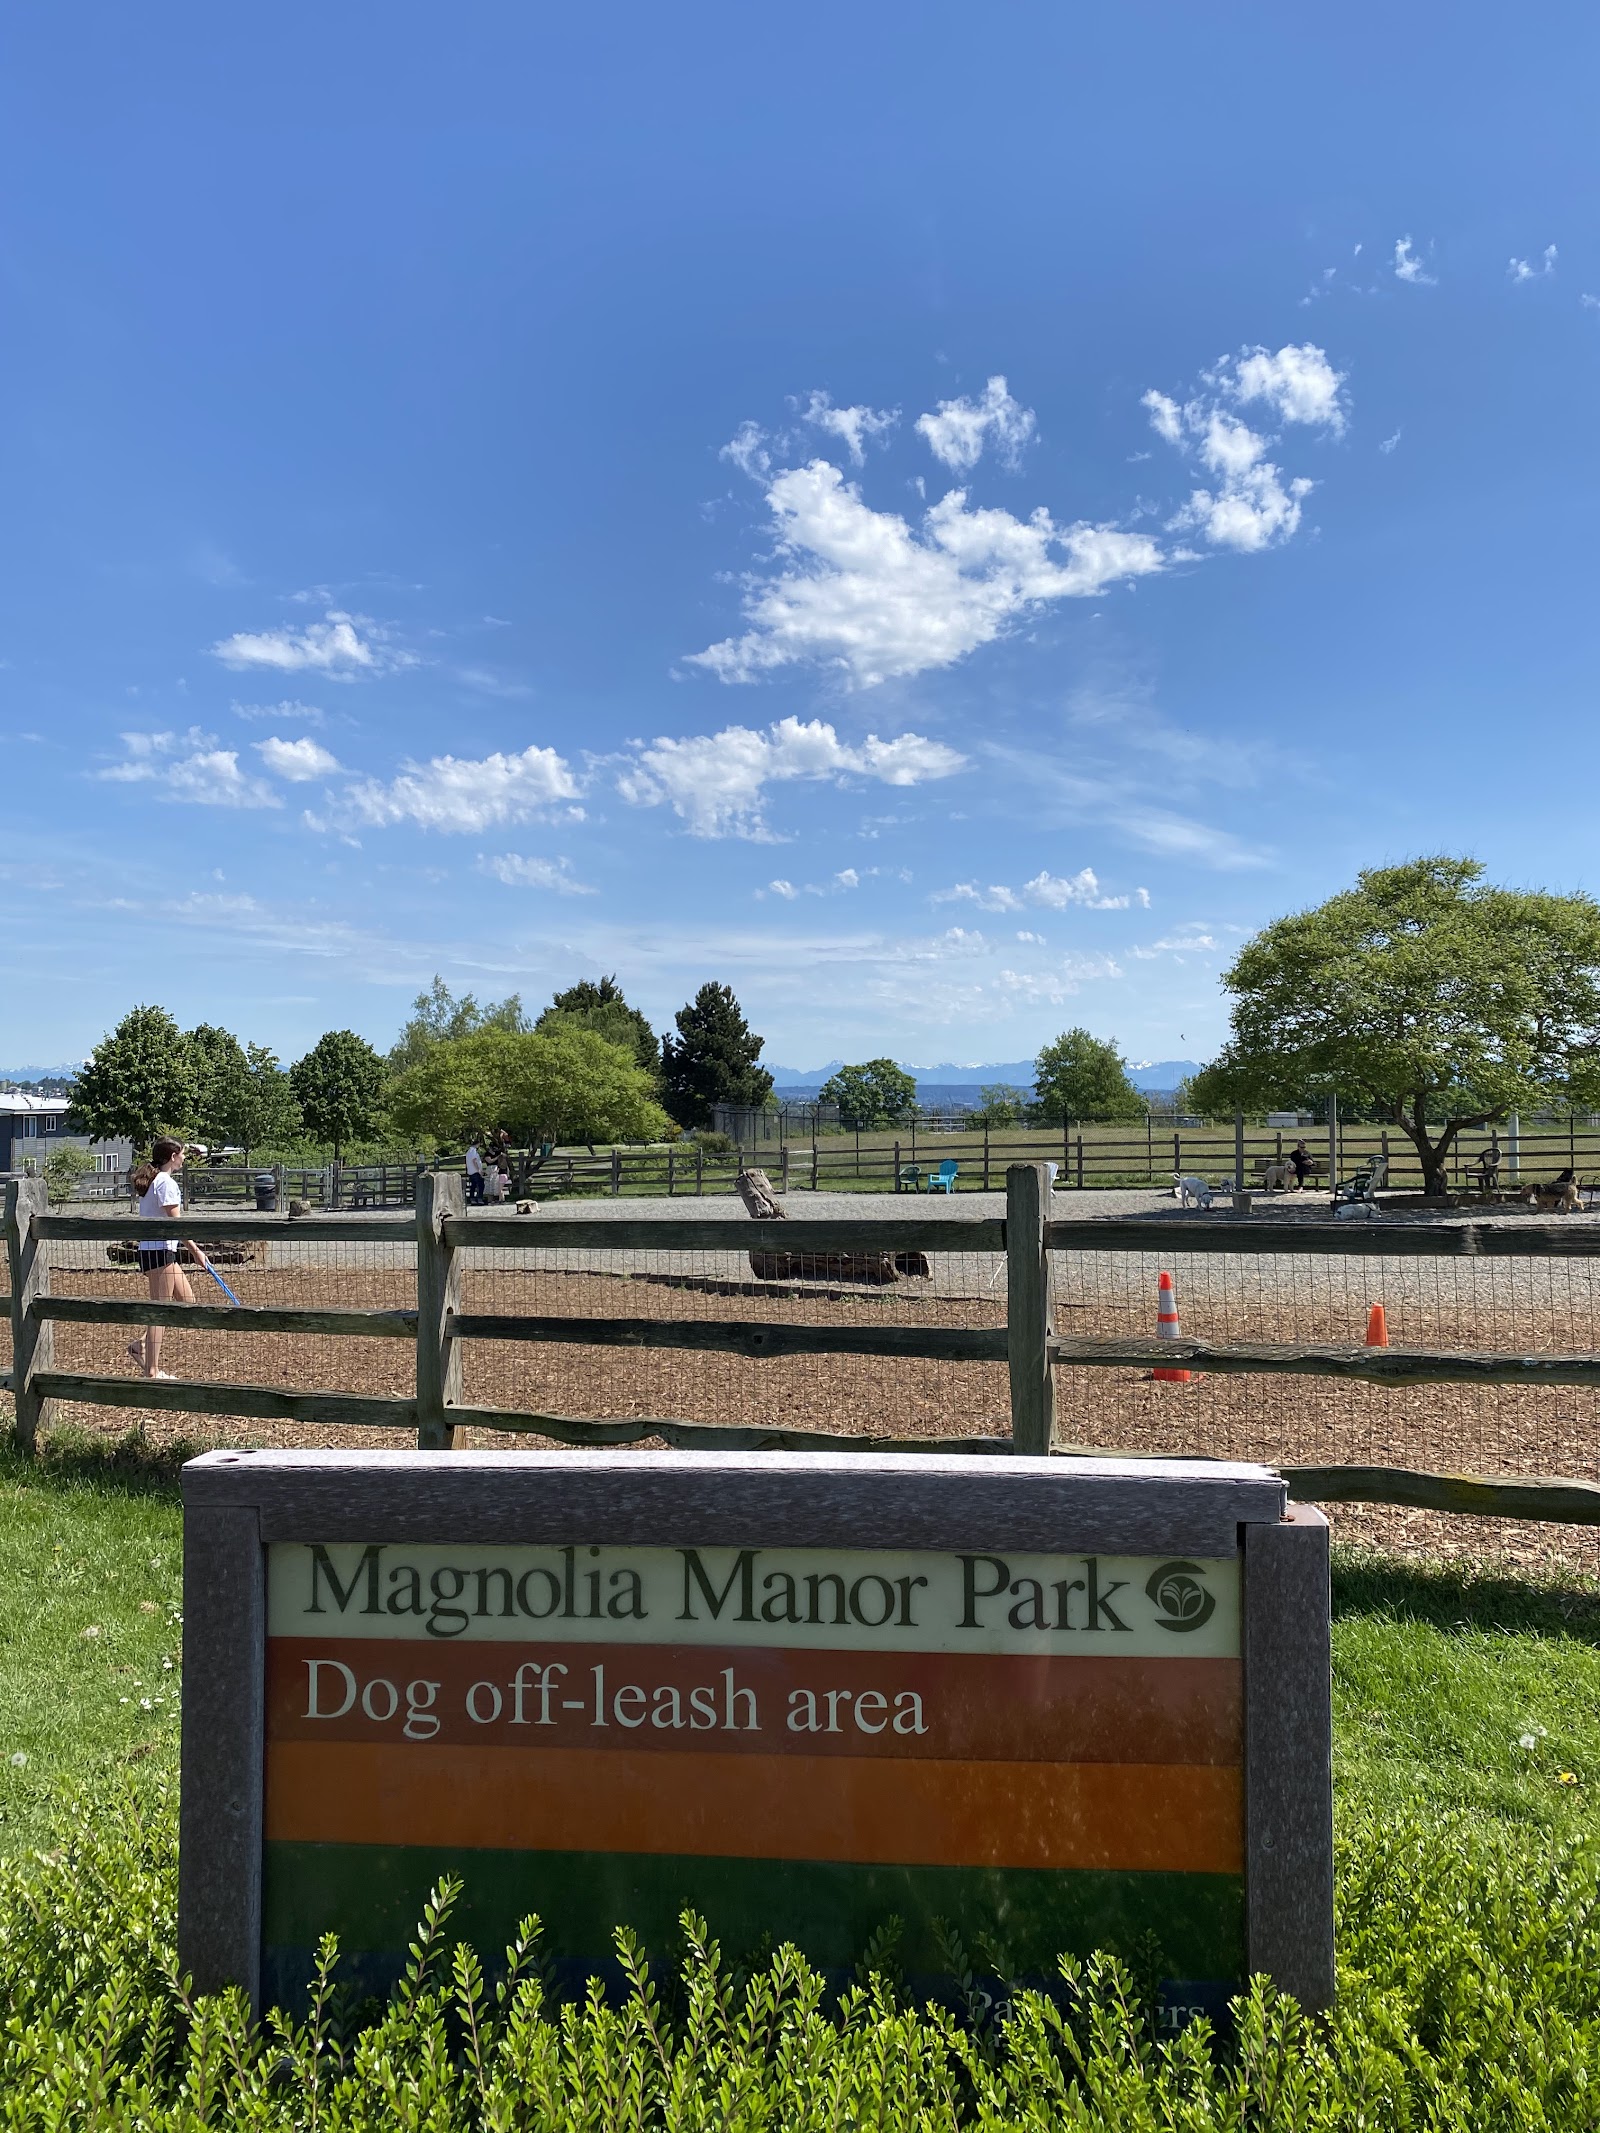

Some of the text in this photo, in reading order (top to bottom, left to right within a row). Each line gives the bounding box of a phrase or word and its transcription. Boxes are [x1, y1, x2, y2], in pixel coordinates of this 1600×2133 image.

[303, 1544, 1134, 1639] Magnolia Manor Park
[300, 1659, 930, 1740] Dog off-leash area
